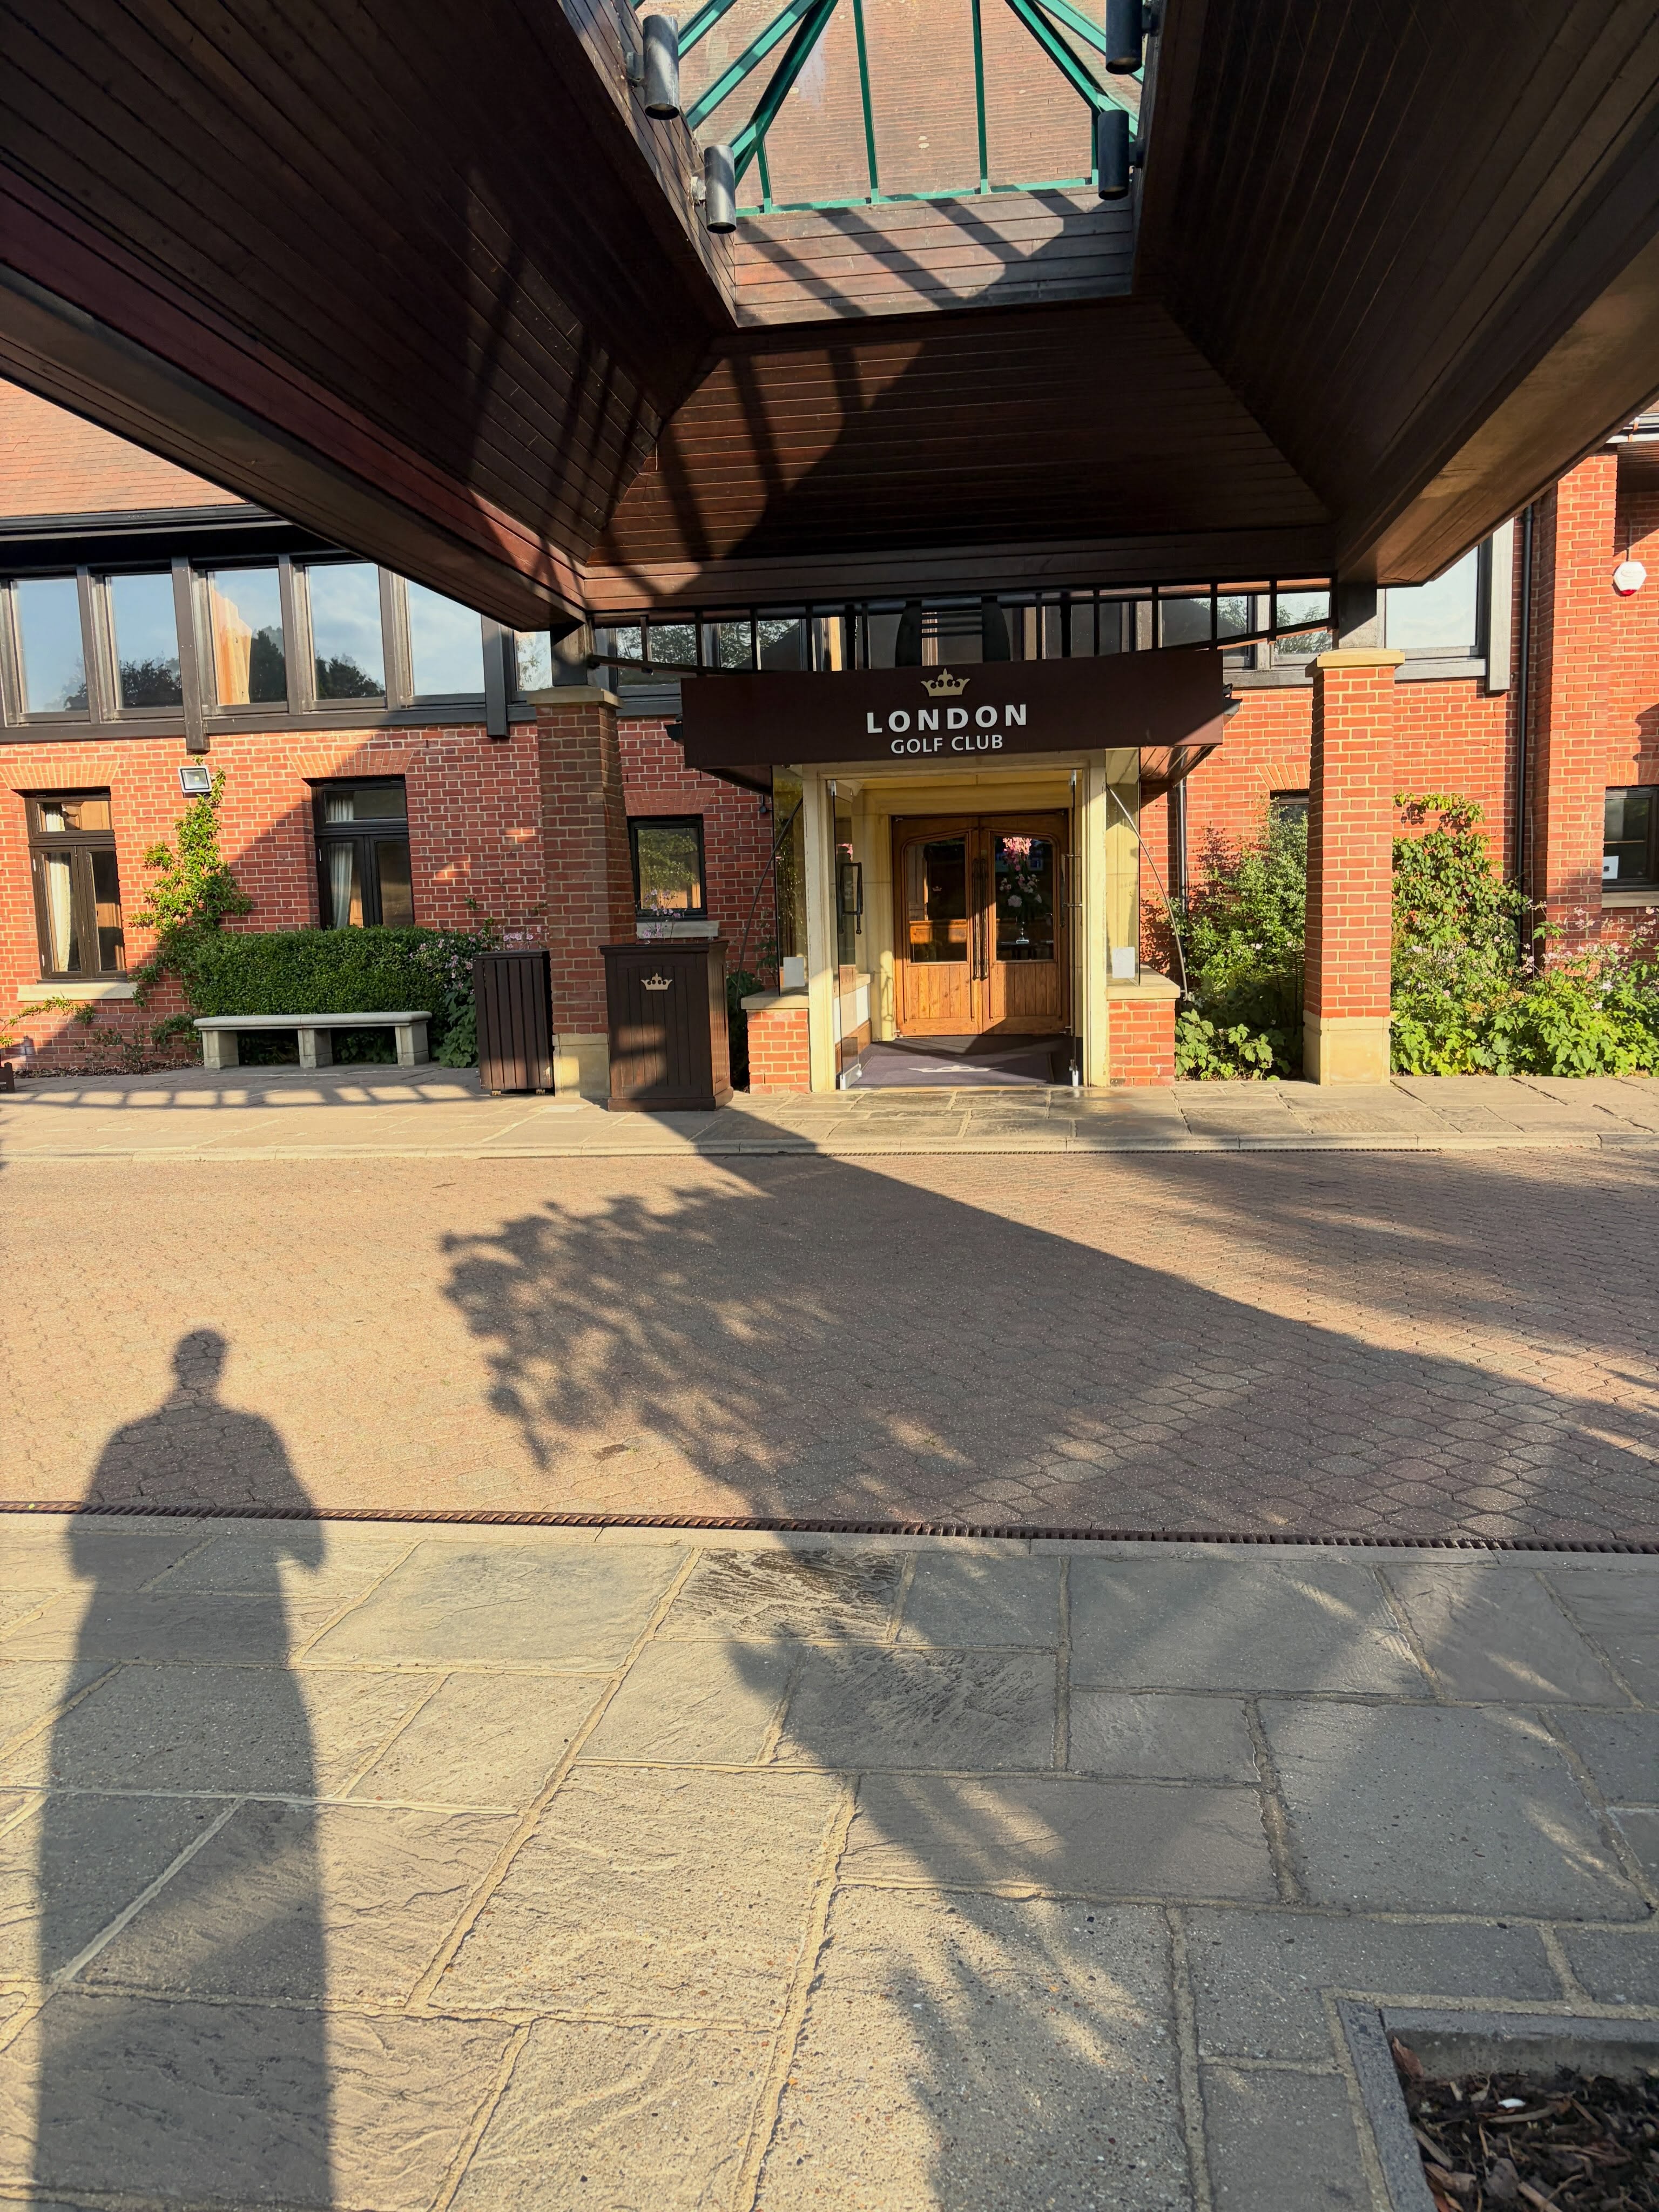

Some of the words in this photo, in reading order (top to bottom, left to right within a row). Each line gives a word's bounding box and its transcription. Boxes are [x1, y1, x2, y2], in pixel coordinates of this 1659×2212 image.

[866, 704, 1027, 734] LONDON
[891, 737, 943, 754] GOLF
[950, 734, 1003, 751] CLUB
